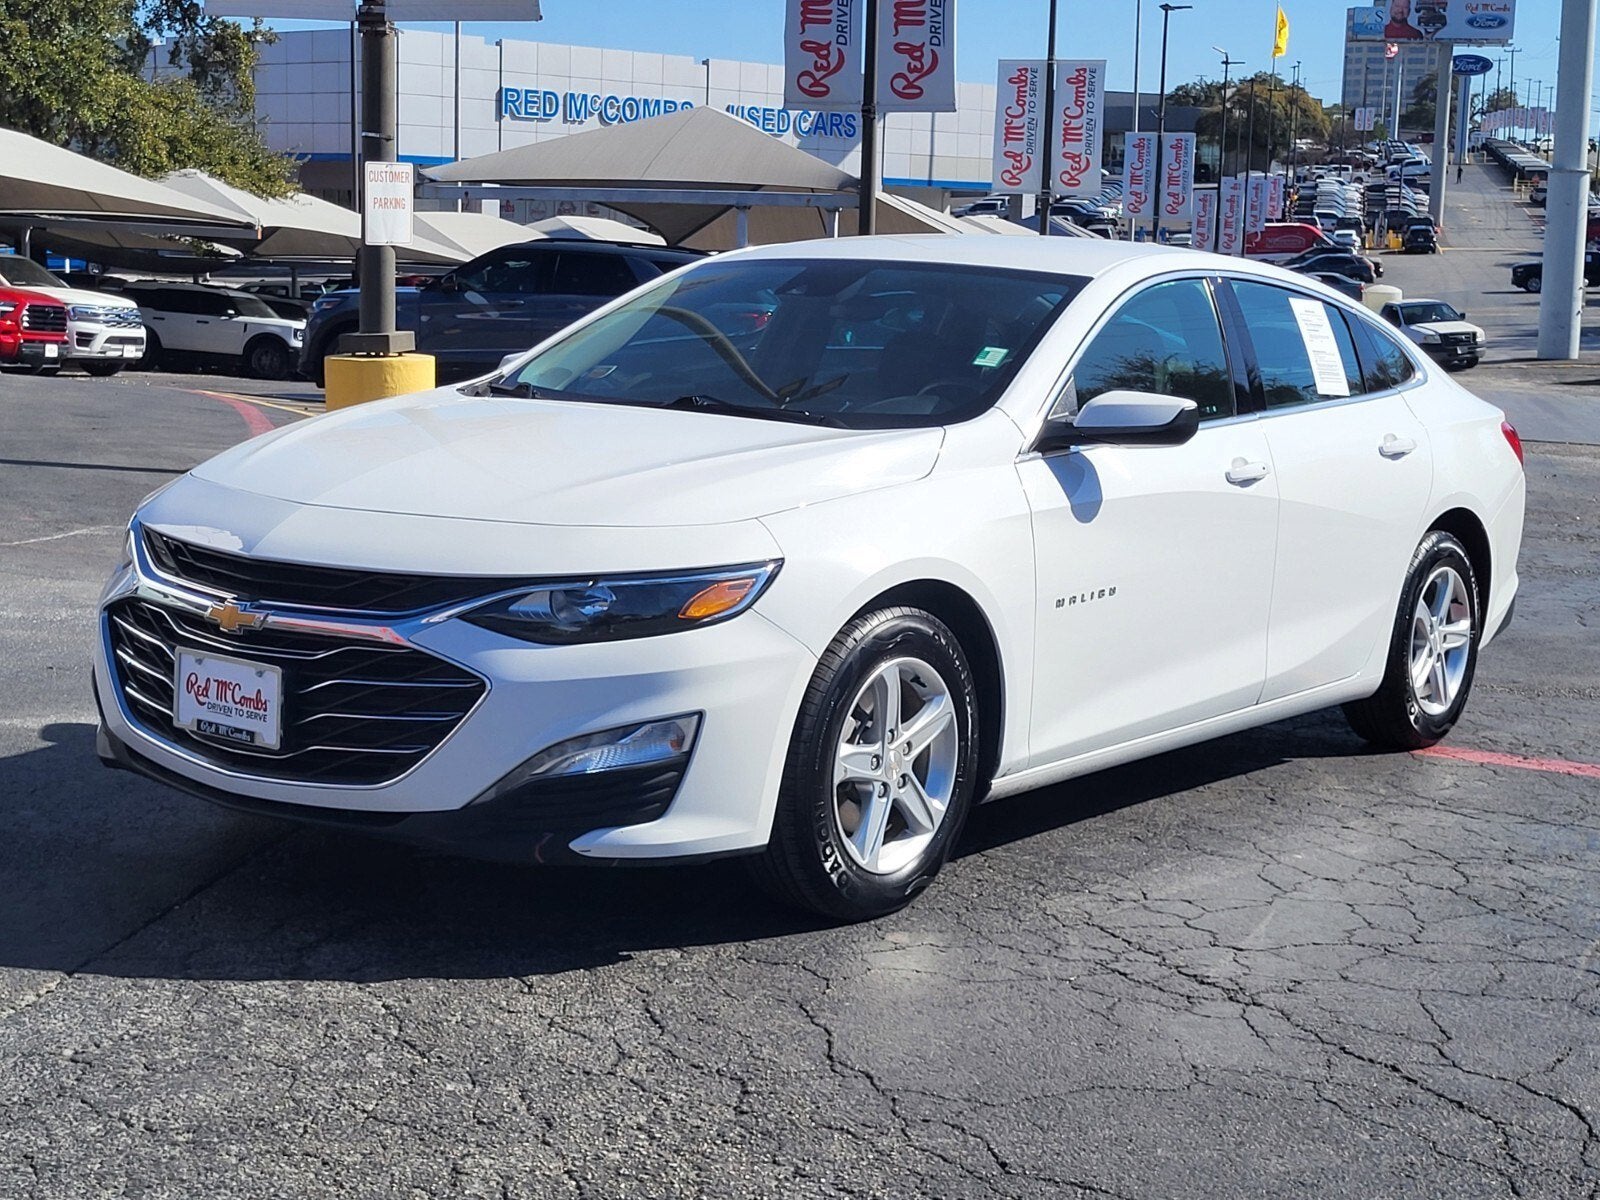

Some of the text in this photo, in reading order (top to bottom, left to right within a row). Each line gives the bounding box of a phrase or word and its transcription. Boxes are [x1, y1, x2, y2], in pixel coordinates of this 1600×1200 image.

[1474, 17, 1500, 27] Ford
[797, 40, 845, 98] Red
[890, 42, 939, 99] Red
[1453, 58, 1483, 71] Ford
[502, 87, 560, 118] RED
[799, 109, 857, 138] CARS
[1000, 67, 1032, 187] Red McCombs
[1026, 67, 1039, 155] DRIVEN TO SERVE
[1059, 67, 1091, 188] Red McCombs
[1084, 67, 1097, 156] DRIVEN TO SERVE
[368, 170, 410, 184] CUSTOMER
[1127, 137, 1148, 214] Red McCombs
[1165, 138, 1186, 215] Red McCombs
[373, 196, 406, 210] PARKING
[1055, 586, 1117, 609] MALIBU
[186, 672, 268, 712] Red McCombs
[207, 701, 268, 723] DRIVEN TO SERVE
